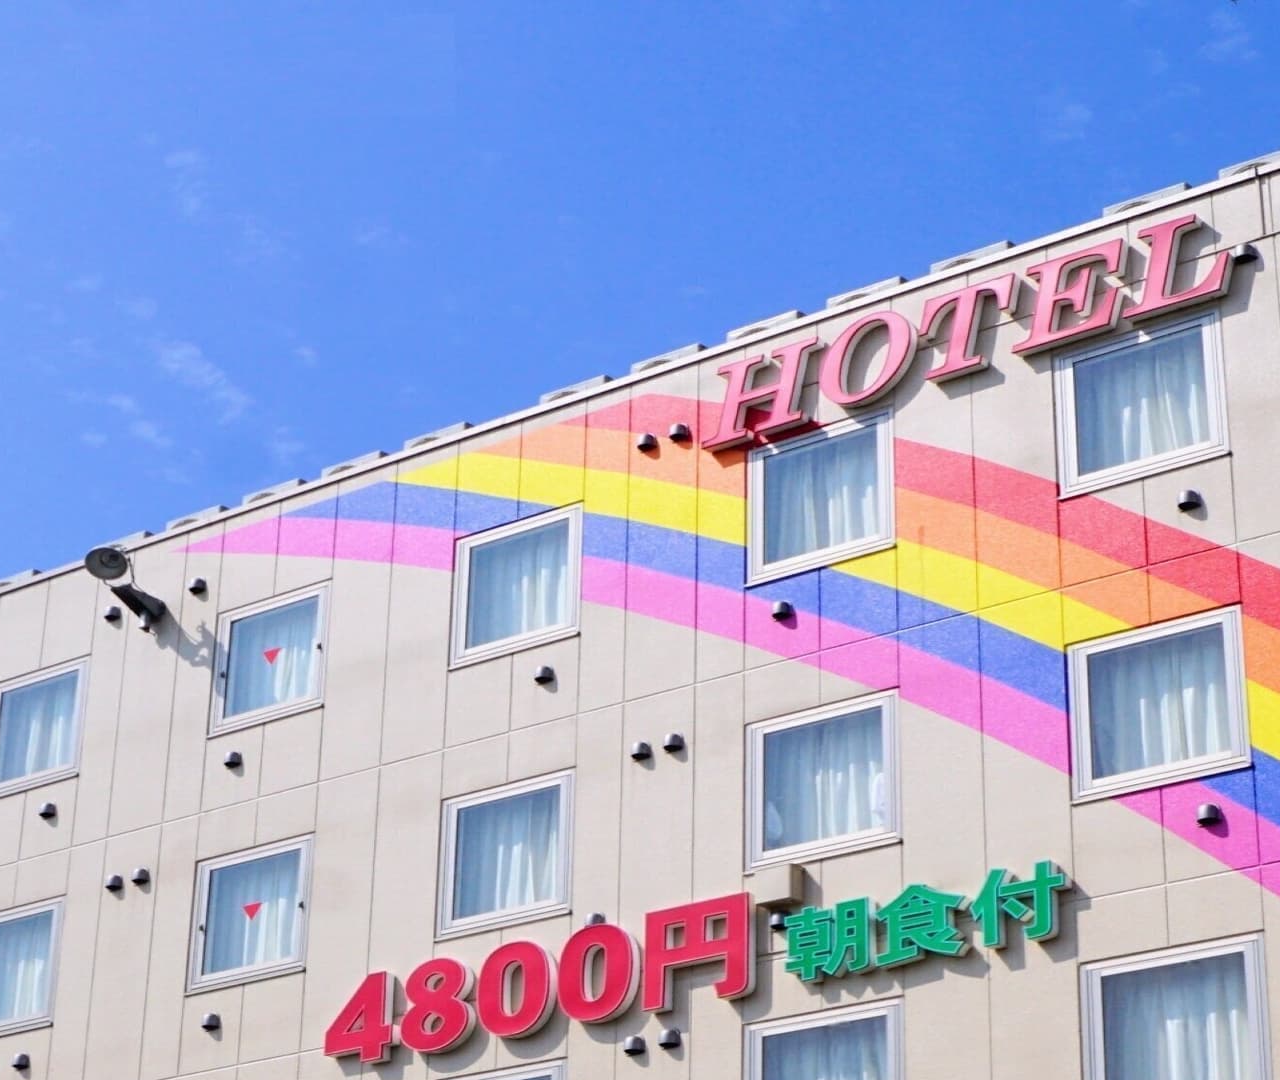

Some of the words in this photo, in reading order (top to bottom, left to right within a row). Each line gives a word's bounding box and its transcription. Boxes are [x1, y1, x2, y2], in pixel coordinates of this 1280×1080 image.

[702, 212, 1235, 453] HOTEL
[323, 890, 758, 1065] 4800円
[784, 859, 1074, 984] 朝食付
